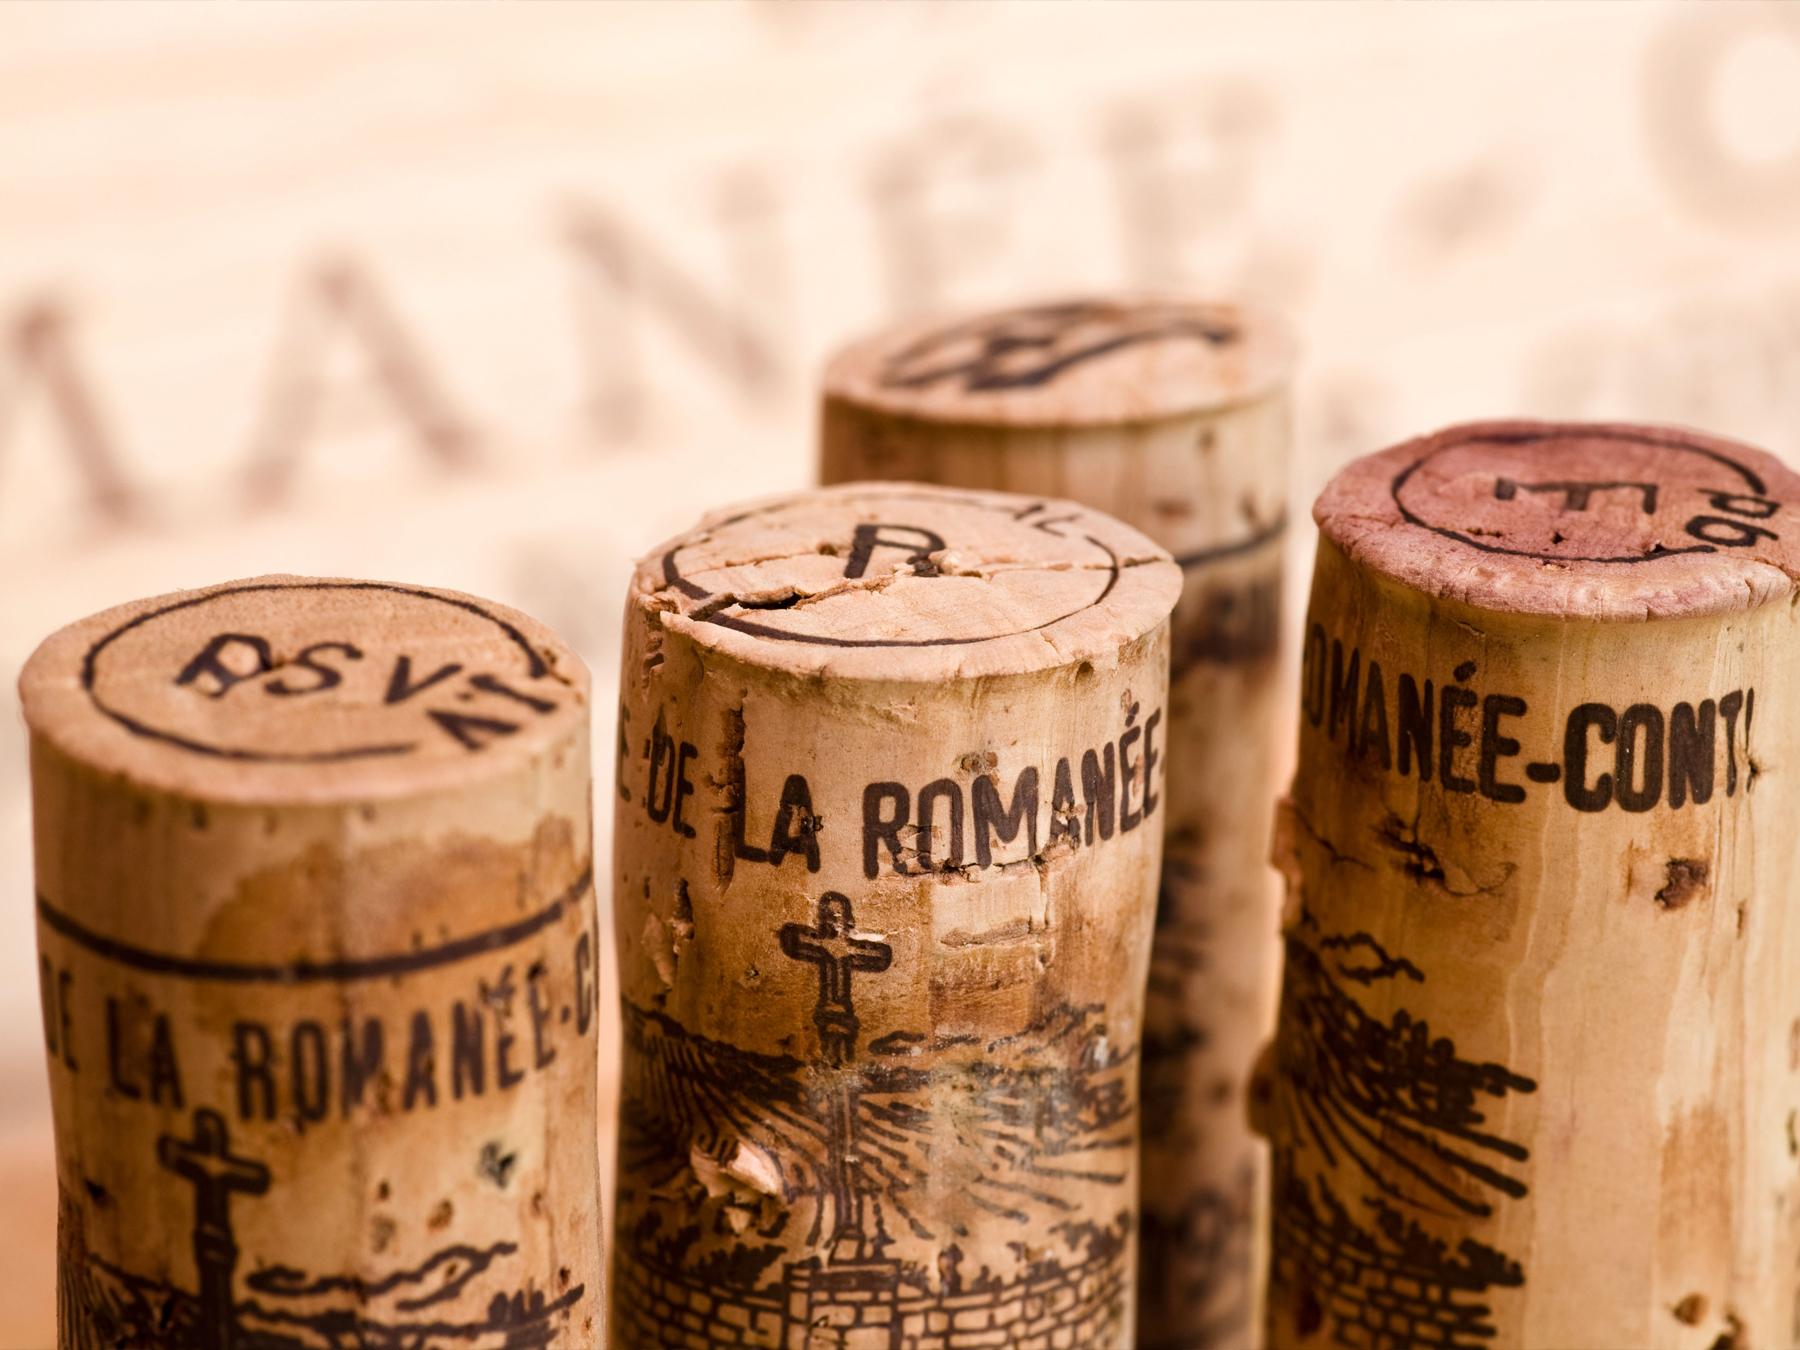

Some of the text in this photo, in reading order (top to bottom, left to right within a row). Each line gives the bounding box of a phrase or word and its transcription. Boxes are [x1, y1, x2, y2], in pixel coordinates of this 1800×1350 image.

[843, 523, 946, 578] R
[1494, 476, 1658, 515] E
[1302, 622, 1756, 812] OMANÉE-CONTI
[732, 750, 822, 874] LA
[105, 995, 186, 1111] LA
